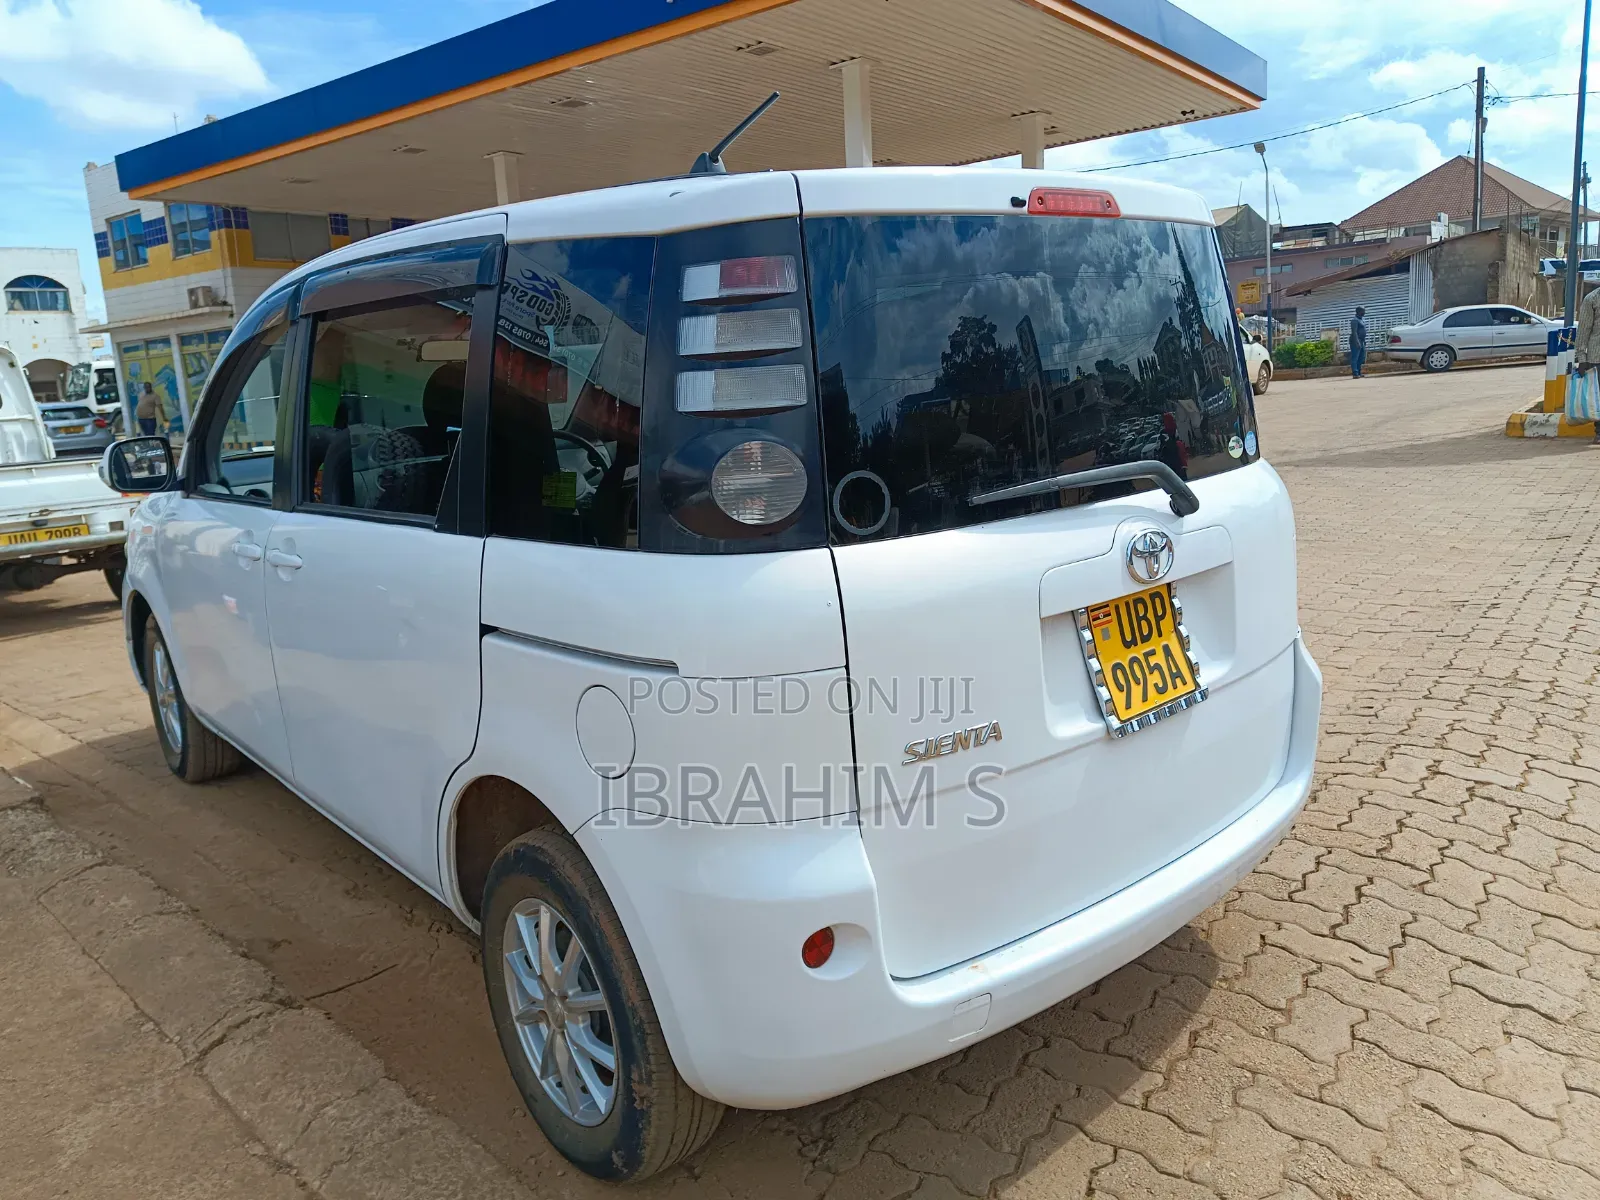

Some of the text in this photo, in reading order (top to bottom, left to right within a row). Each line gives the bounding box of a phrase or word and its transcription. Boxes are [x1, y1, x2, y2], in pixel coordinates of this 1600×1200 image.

[1114, 591, 1167, 649] UBP
[1111, 643, 1187, 710] 995A
[902, 720, 1003, 766] SIENTA
